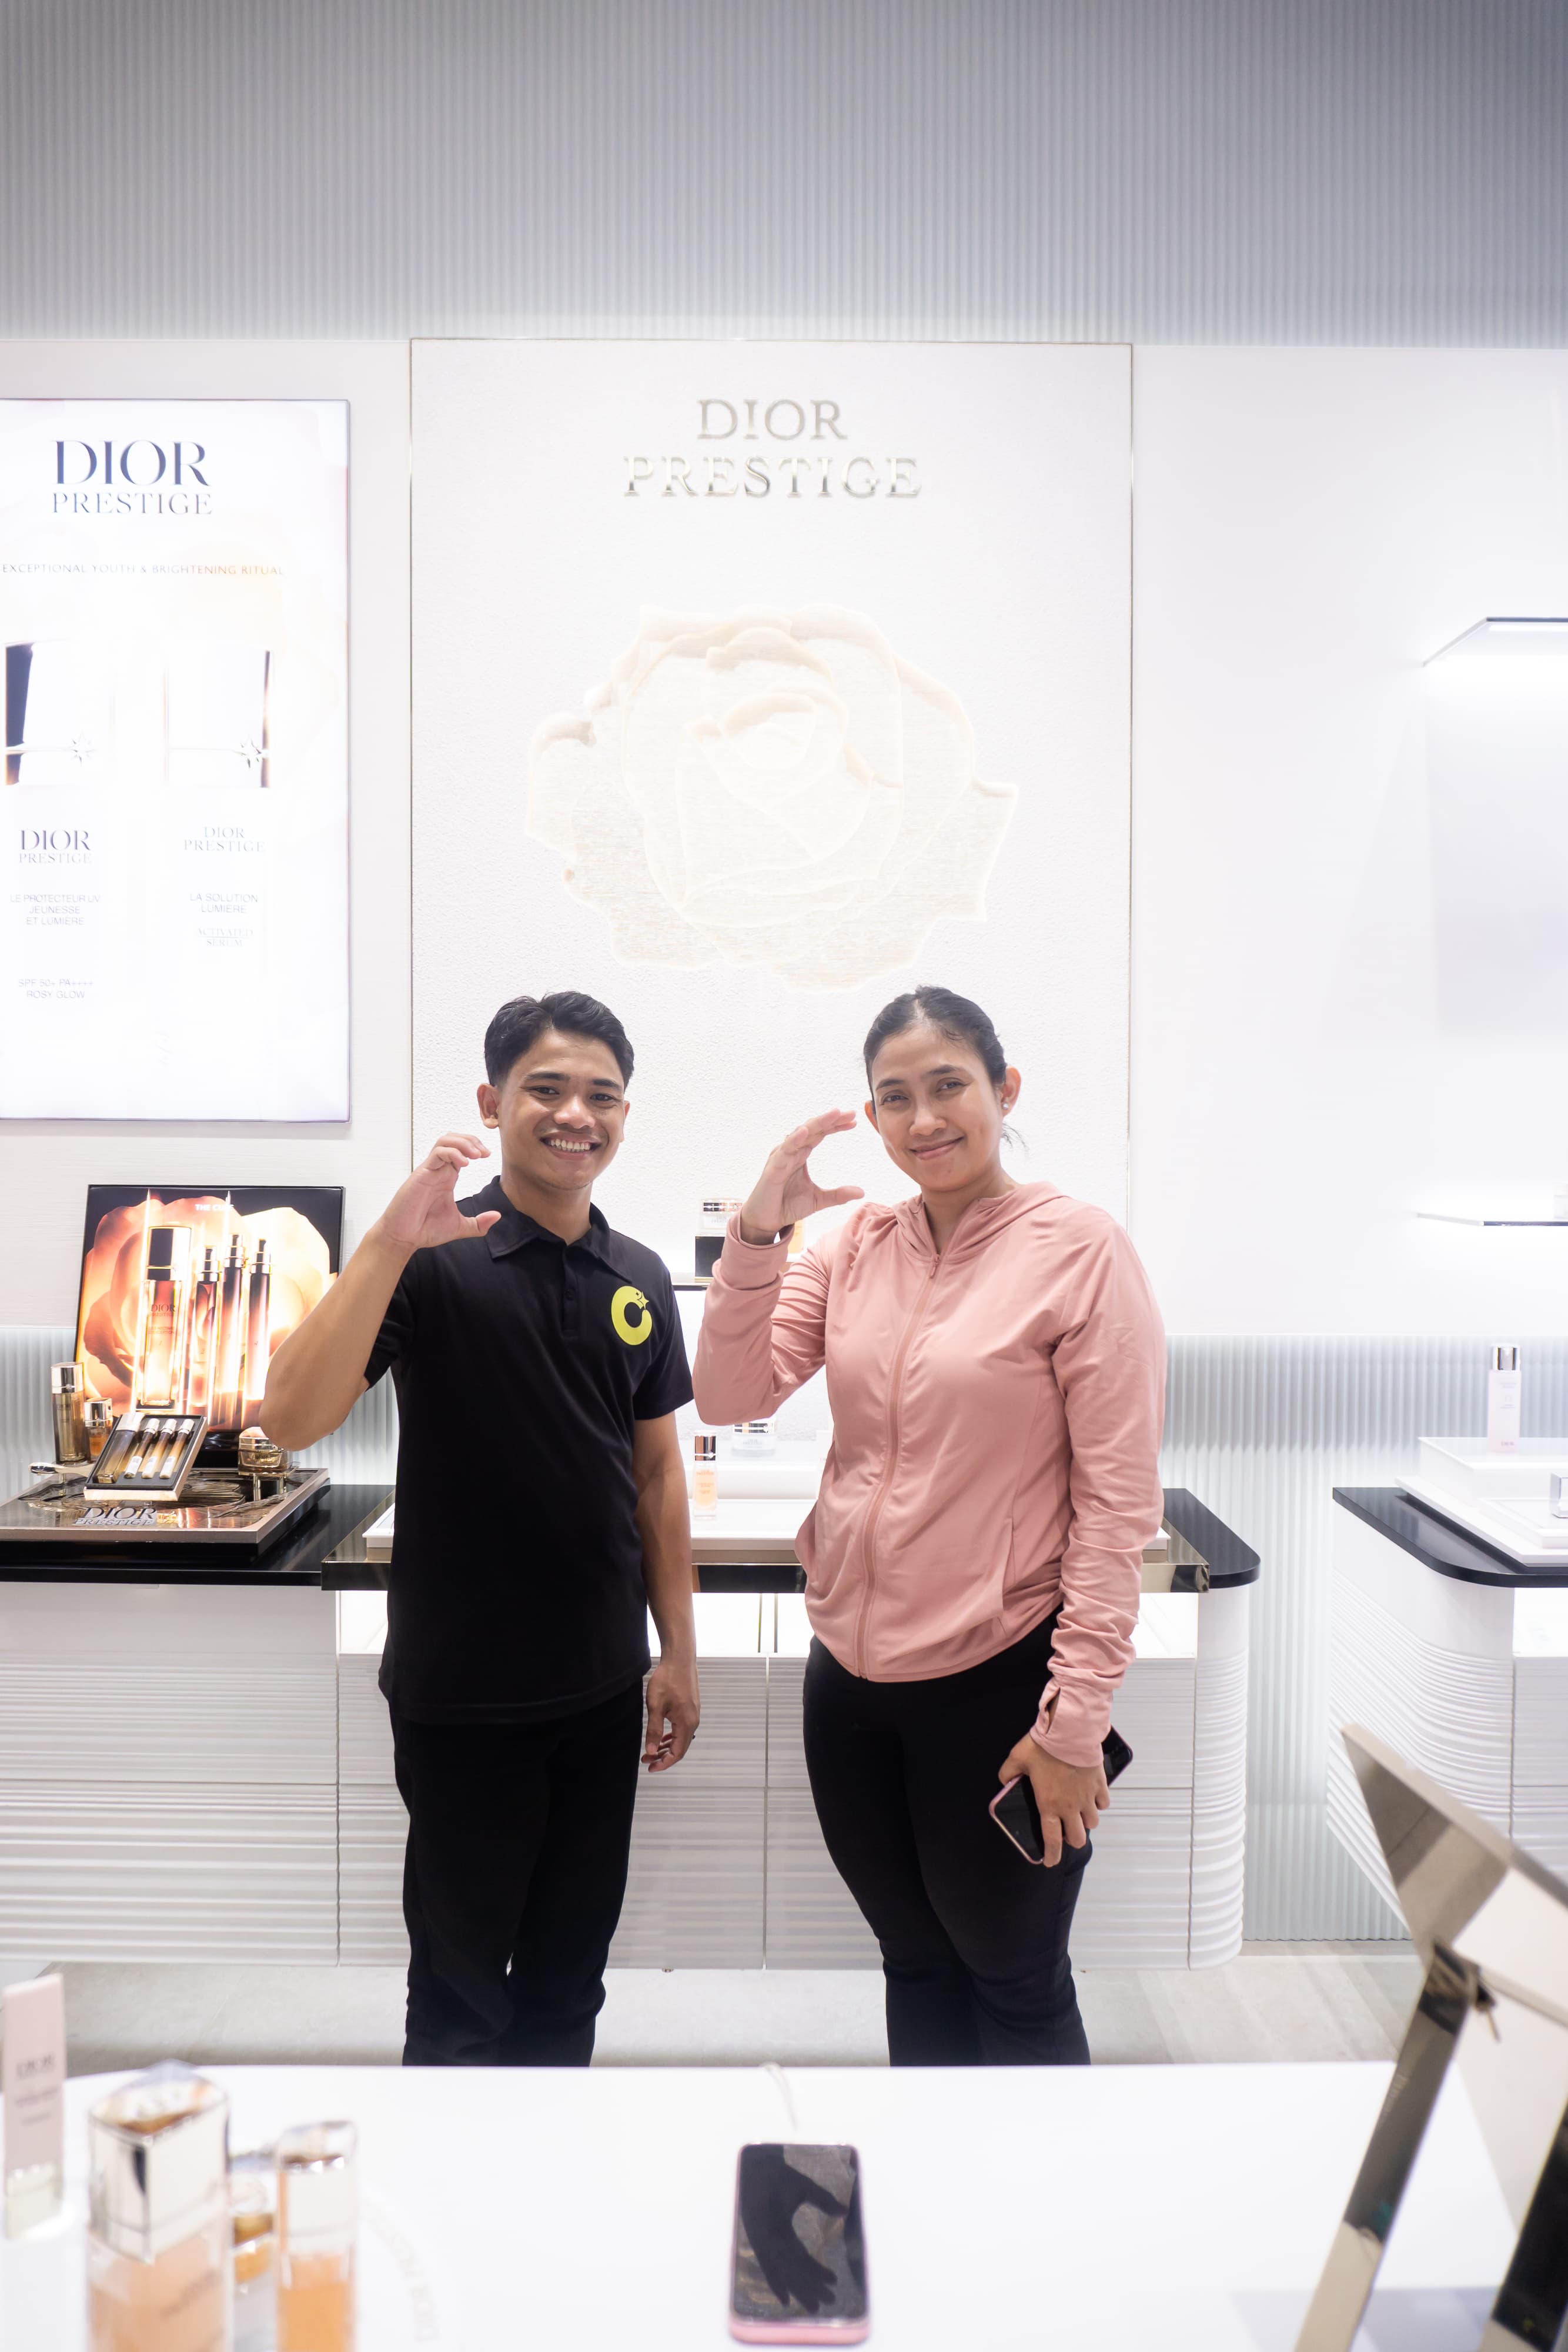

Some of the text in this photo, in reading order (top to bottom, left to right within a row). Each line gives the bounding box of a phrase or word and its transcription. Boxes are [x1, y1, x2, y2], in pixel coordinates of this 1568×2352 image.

[697, 399, 848, 440] DIOR
[50, 439, 212, 487] DIOR
[623, 455, 921, 499] PRESTIGE
[52, 492, 212, 515] PRESTIGE
[2, 563, 285, 576] EXCEPTIONAL YOUTH & BRIGHTENING RITUAL
[203, 826, 245, 838] DIOR
[19, 830, 91, 850] DIOR
[183, 839, 266, 853] PRESTIGE
[19, 853, 92, 864] PRESTIGE
[10, 894, 21, 903] LE
[23, 893, 86, 903] PROTECTEUR
[189, 893, 259, 903] LA SOLUTION
[29, 905, 81, 914] JEUNESSE
[26, 917, 38, 926] ET
[26, 990, 85, 999] ROSY GLOW
[151, 1304, 176, 1312] DIOR
[82, 1506, 157, 1519] DIOR
